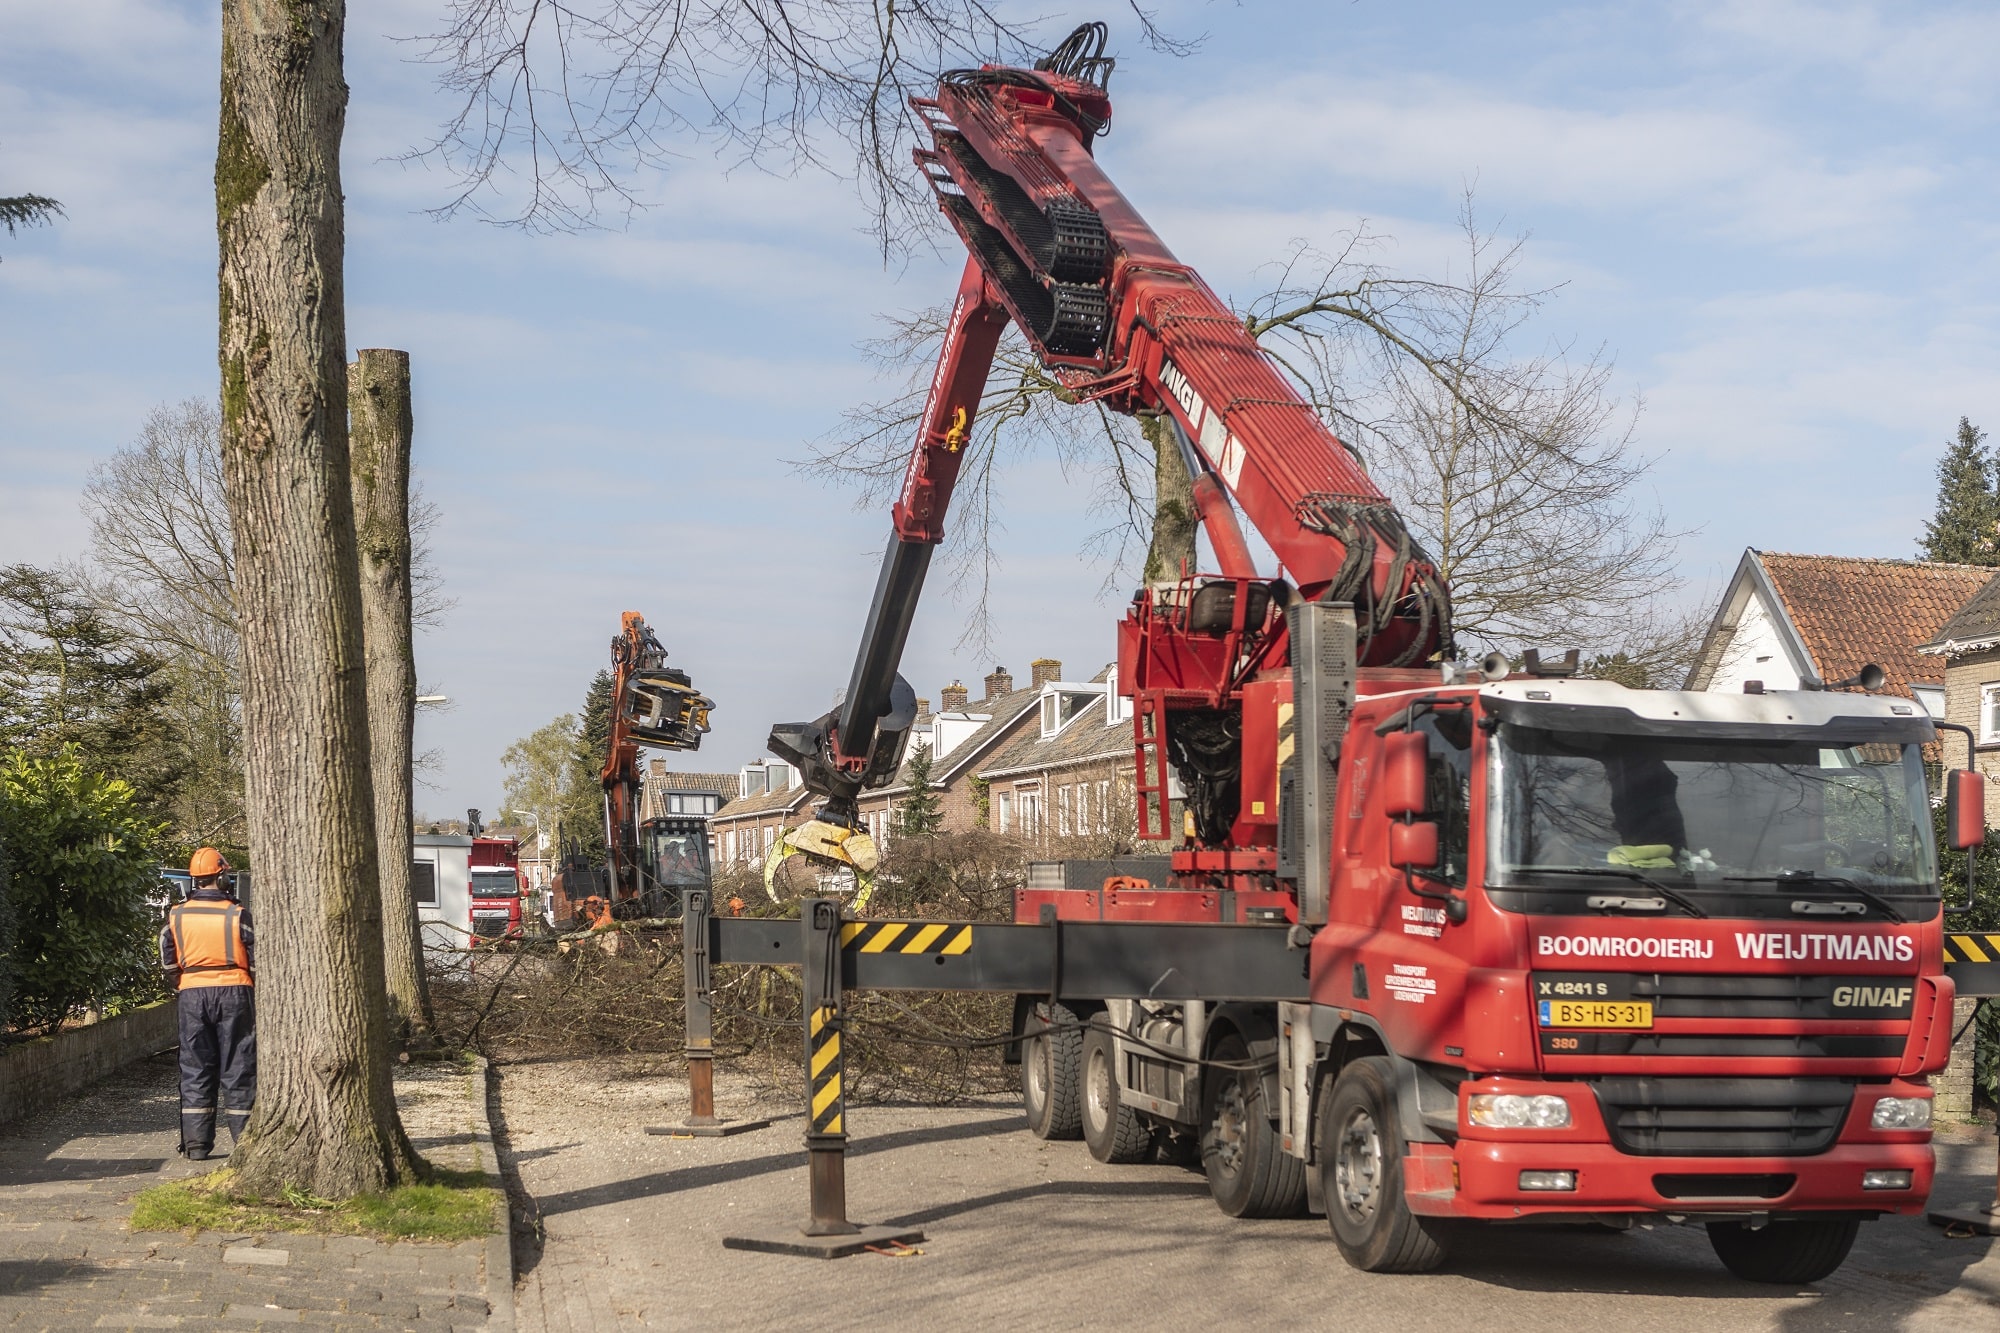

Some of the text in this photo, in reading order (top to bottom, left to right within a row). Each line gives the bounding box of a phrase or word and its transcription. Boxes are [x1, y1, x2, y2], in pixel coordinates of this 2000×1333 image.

[936, 293, 965, 390] WEIJTMANS
[1401, 904, 1446, 924] WEIJTMANS
[1538, 932, 1914, 962] BOOMROOIERIJ WEIJTMANS
[1393, 963, 1428, 977] TRANSPORT
[1393, 990, 1426, 1004] UDENHOUT
[1539, 982, 1608, 996] X 4241 S
[1832, 986, 1913, 1008] GINAF
[1561, 1005, 1644, 1023] BS-HS-31
[1551, 1037, 1579, 1049] 380
